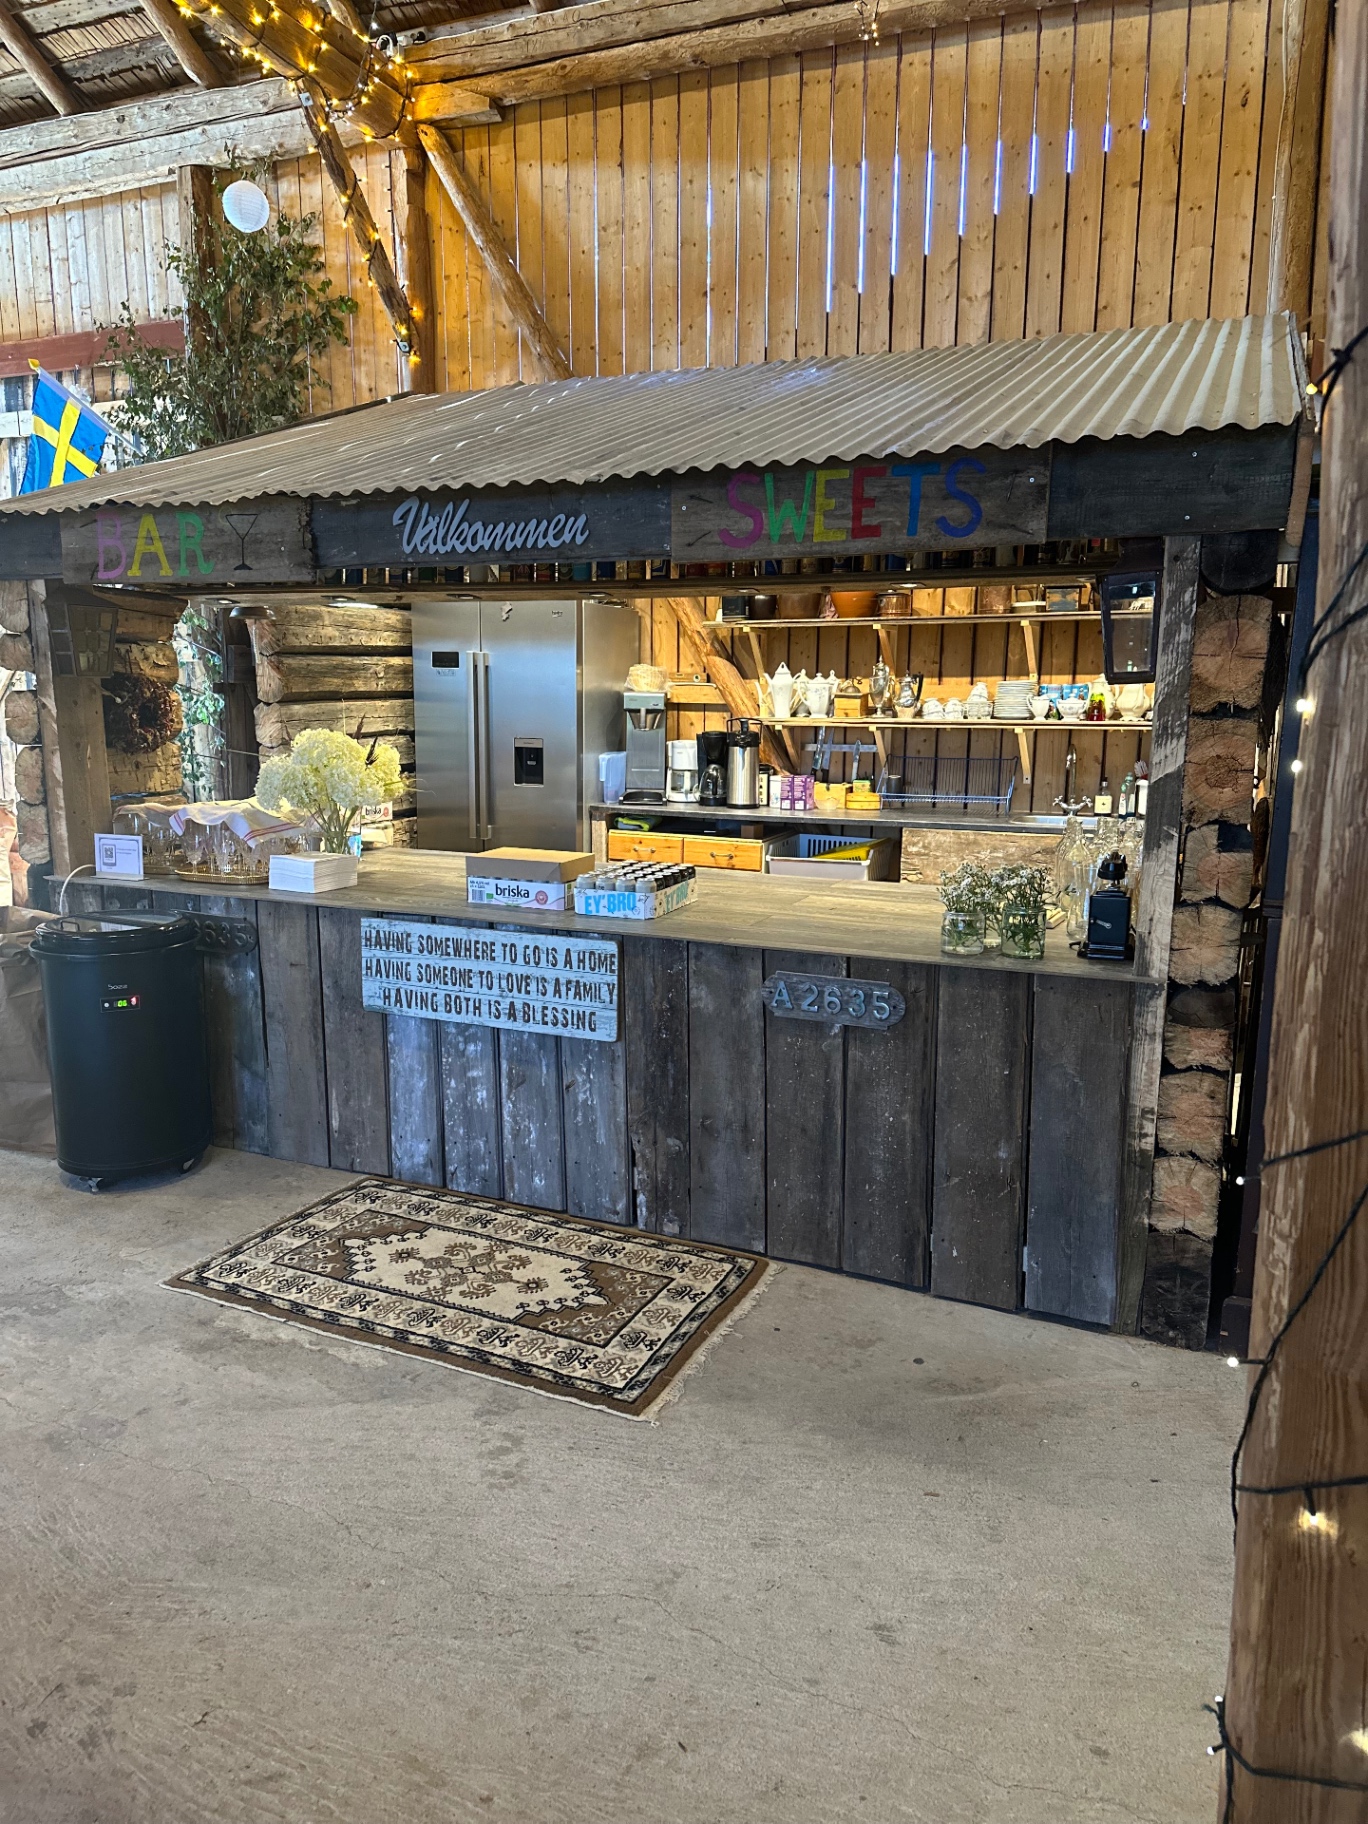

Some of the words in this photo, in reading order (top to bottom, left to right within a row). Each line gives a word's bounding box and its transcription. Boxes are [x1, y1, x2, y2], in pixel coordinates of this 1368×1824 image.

[393, 496, 589, 554] Välkommen
[718, 457, 986, 548] SWEETS
[97, 511, 214, 579] BAR
[495, 883, 530, 898] briska
[364, 930, 412, 953] HAVING
[418, 934, 496, 961] SOMEWHERE
[502, 942, 517, 963] TO
[523, 945, 541, 966] GO
[546, 947, 558, 967] IS
[563, 948, 573, 969] A
[578, 951, 616, 974] HOME
[365, 958, 412, 982] HAVING
[417, 963, 473, 988] SOMEONE
[479, 970, 494, 990] TO
[499, 972, 531, 995] LOVE
[536, 976, 548, 997] IS
[552, 978, 562, 998] A
[566, 979, 616, 1004] FAMILY
[383, 987, 438, 1012] HAVING
[444, 994, 482, 1017] BOTH
[488, 999, 500, 1019] IS
[507, 1001, 517, 1022] A
[523, 1002, 597, 1032] BLESSING
